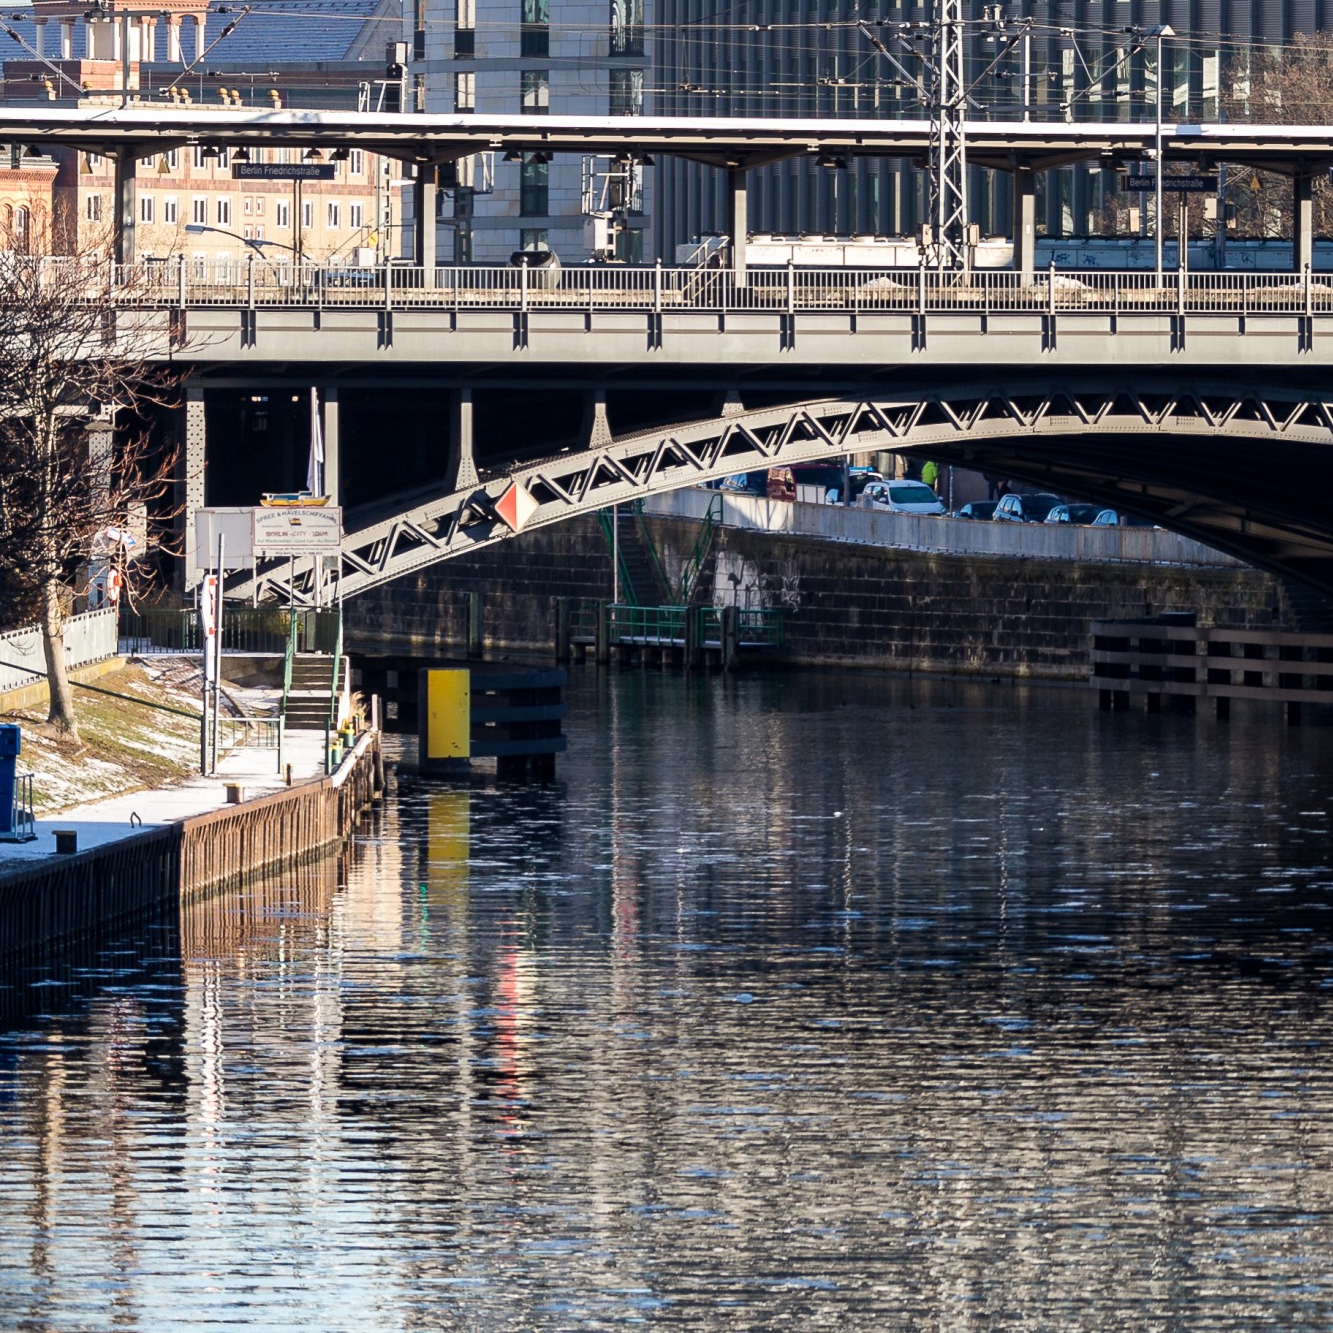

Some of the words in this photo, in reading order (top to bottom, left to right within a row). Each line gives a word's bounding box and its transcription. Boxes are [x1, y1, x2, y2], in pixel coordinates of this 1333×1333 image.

[240, 165, 262, 175] Berlin
[264, 165, 320, 176] Friedrichstraße
[1129, 177, 1150, 187] Berlin
[1151, 177, 1204, 188] Fedrichstraße
[255, 513, 277, 524] SPREE
